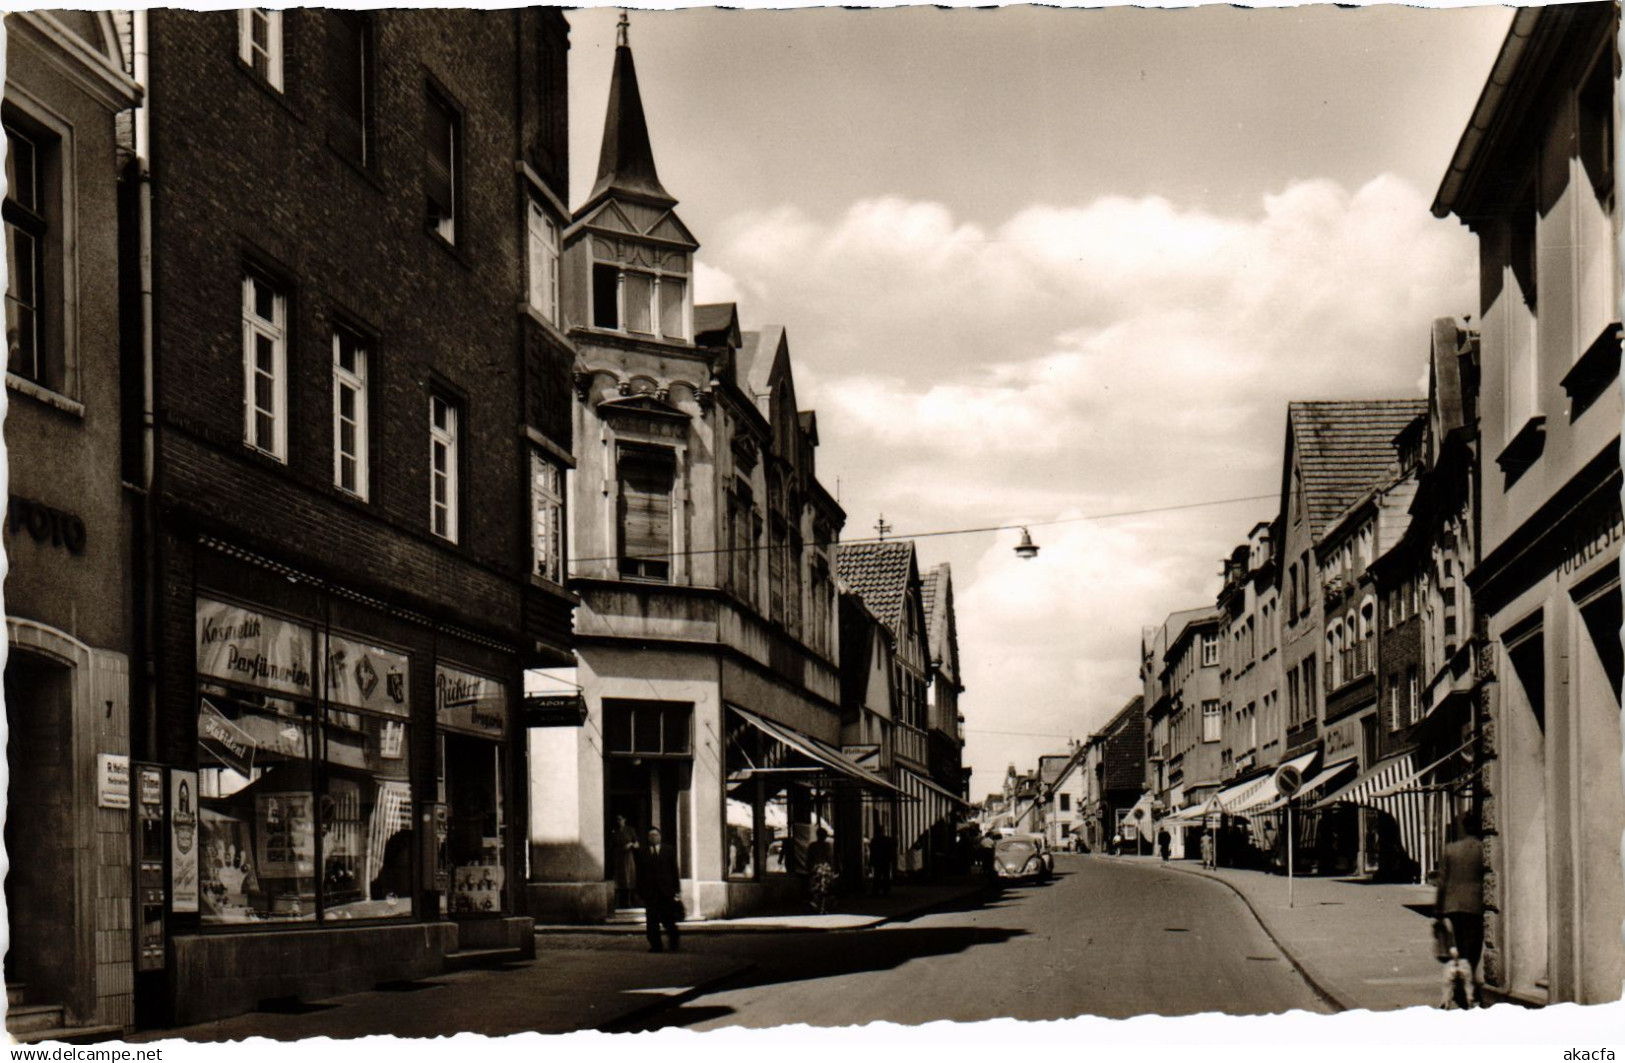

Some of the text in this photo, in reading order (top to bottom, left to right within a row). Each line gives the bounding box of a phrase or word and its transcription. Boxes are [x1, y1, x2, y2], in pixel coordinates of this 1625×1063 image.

[10, 495, 87, 556] FOTO
[202, 617, 261, 645] Kosmetik
[228, 644, 310, 687] Parfümerien
[105, 700, 113, 718] 7
